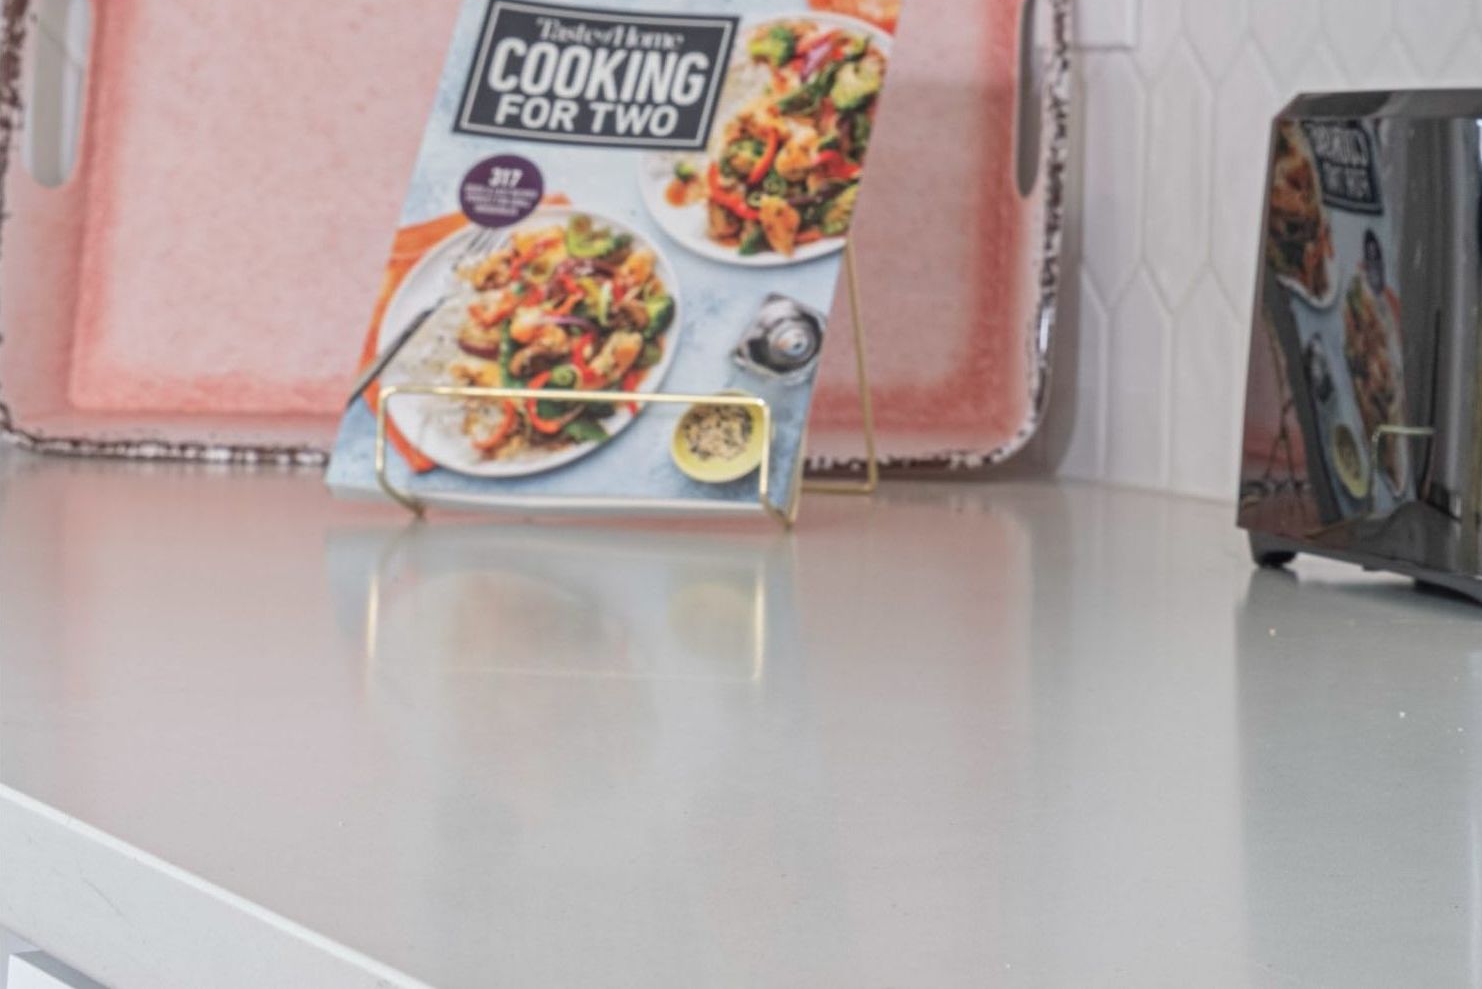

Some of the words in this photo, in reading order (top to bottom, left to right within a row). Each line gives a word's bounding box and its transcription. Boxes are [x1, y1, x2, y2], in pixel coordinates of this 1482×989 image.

[488, 37, 709, 106] COOKING
[495, 93, 579, 131] FOR
[589, 100, 679, 137] TWO
